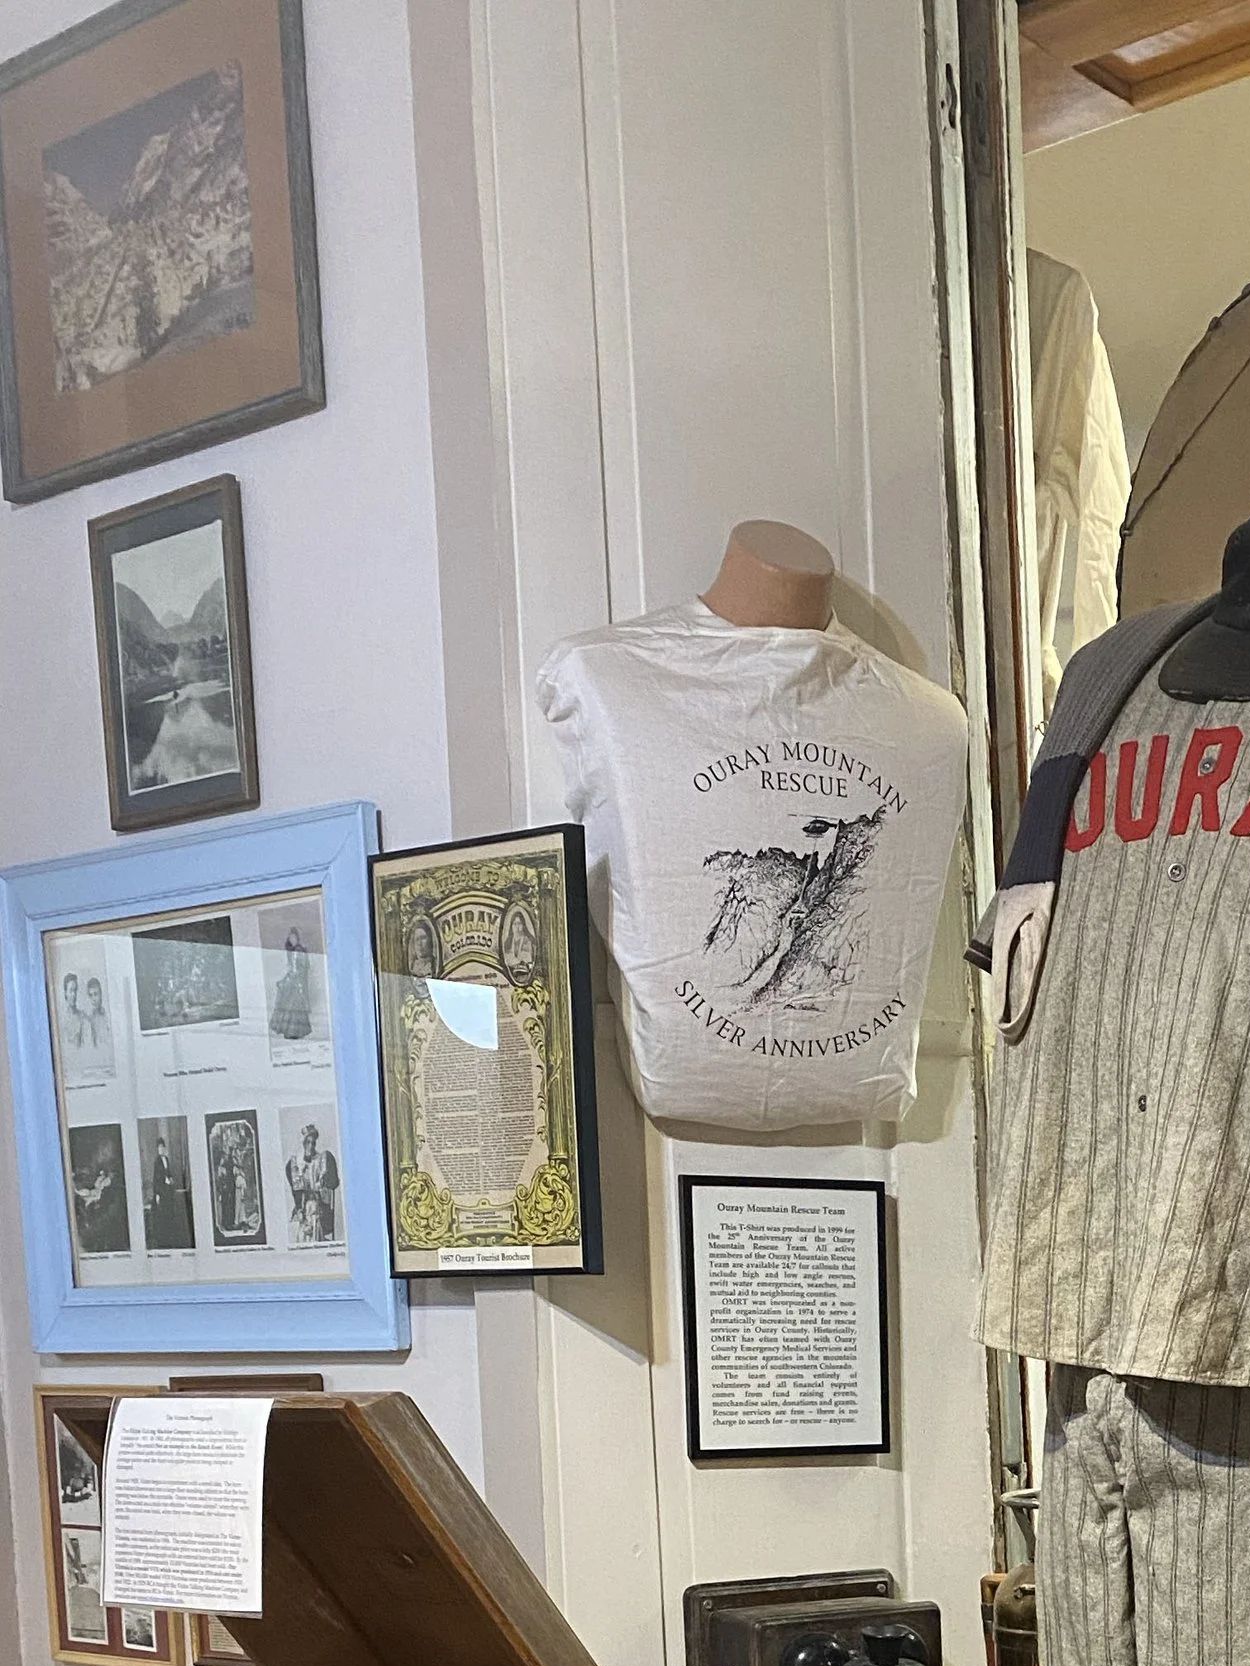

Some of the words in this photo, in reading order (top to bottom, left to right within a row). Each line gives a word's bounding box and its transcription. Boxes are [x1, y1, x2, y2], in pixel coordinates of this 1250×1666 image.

[694, 744, 772, 794] OURAY
[781, 741, 908, 814] MOUNTAIN
[760, 770, 848, 798] RESCUE
[674, 980, 746, 1047] SILVER
[752, 991, 908, 1059] ANNIVERSARY
[717, 1203, 744, 1214] Ouray
[747, 1204, 788, 1214] Mountain
[791, 1205, 820, 1215] Rescue
[822, 1207, 845, 1215] Team
